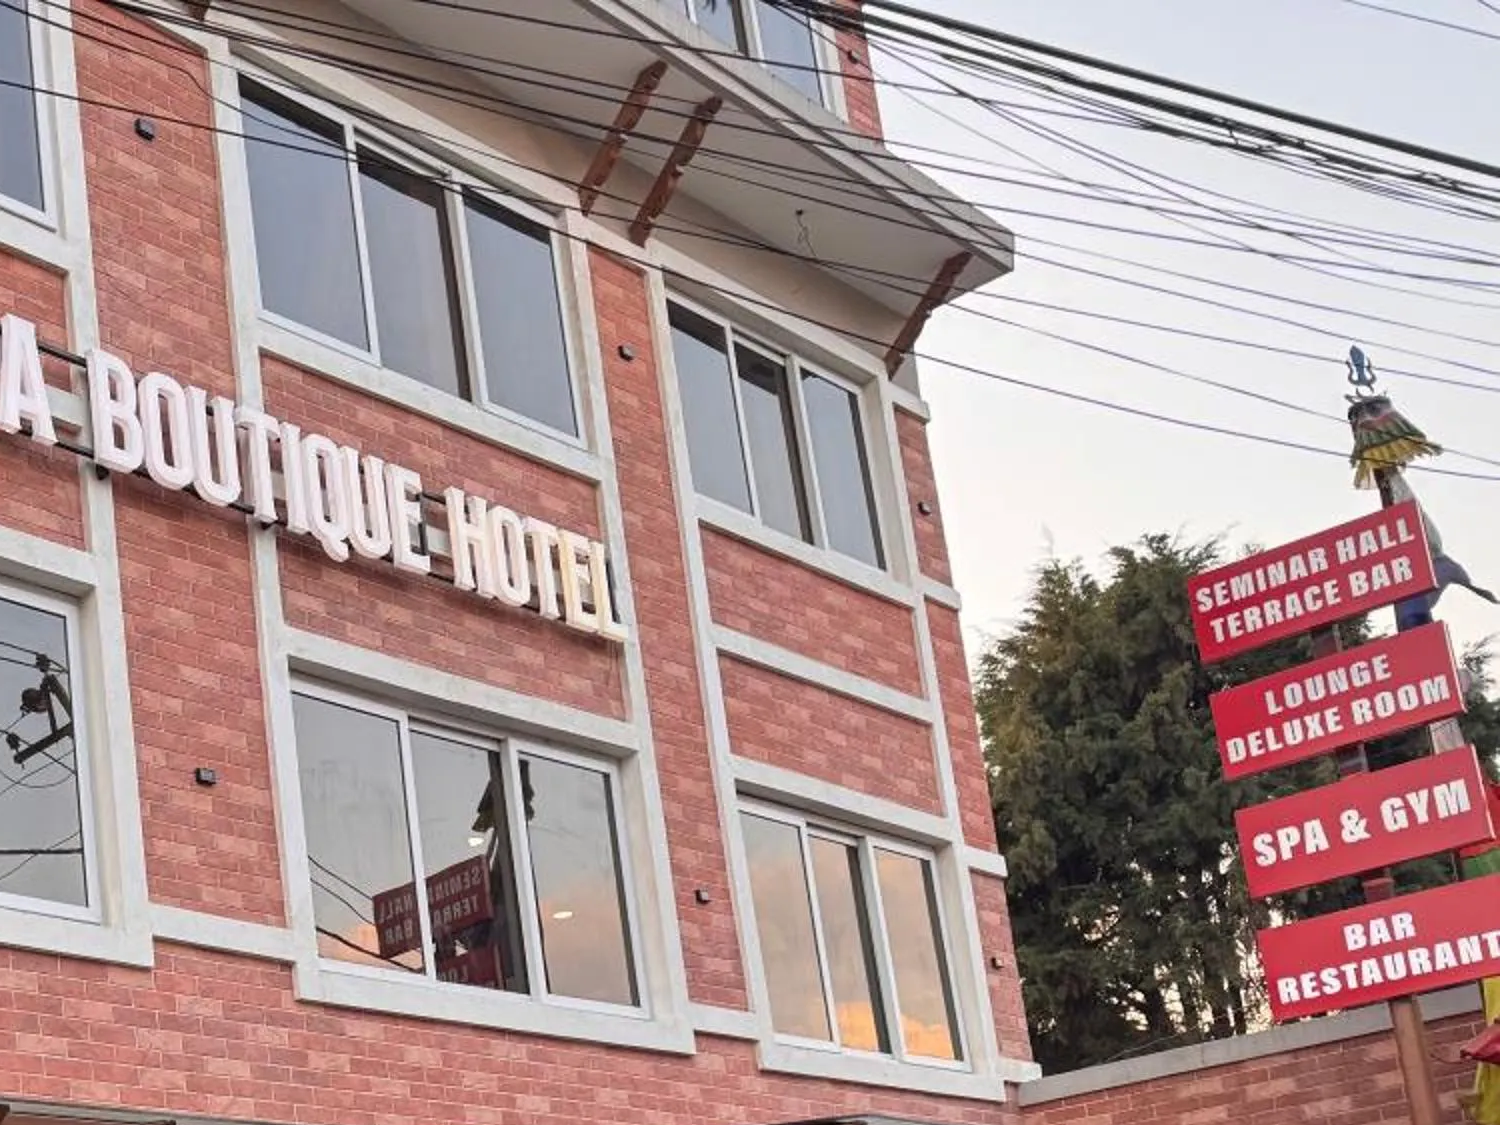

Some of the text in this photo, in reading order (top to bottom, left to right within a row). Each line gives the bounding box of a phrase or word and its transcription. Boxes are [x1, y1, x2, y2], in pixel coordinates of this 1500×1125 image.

[87, 348, 431, 576] BOUTIQUE
[445, 486, 628, 641] HOTEL
[1196, 516, 1416, 613] SEMINAR HALL
[1210, 555, 1414, 643] TERRACE BAR
[1225, 675, 1451, 764] DELUXE ROOM
[1263, 653, 1392, 715] LOUNGE
[1252, 778, 1472, 868] SPA & GYM
[1277, 932, 1500, 1005] RESTAURANT
[1343, 912, 1416, 952] BAR
